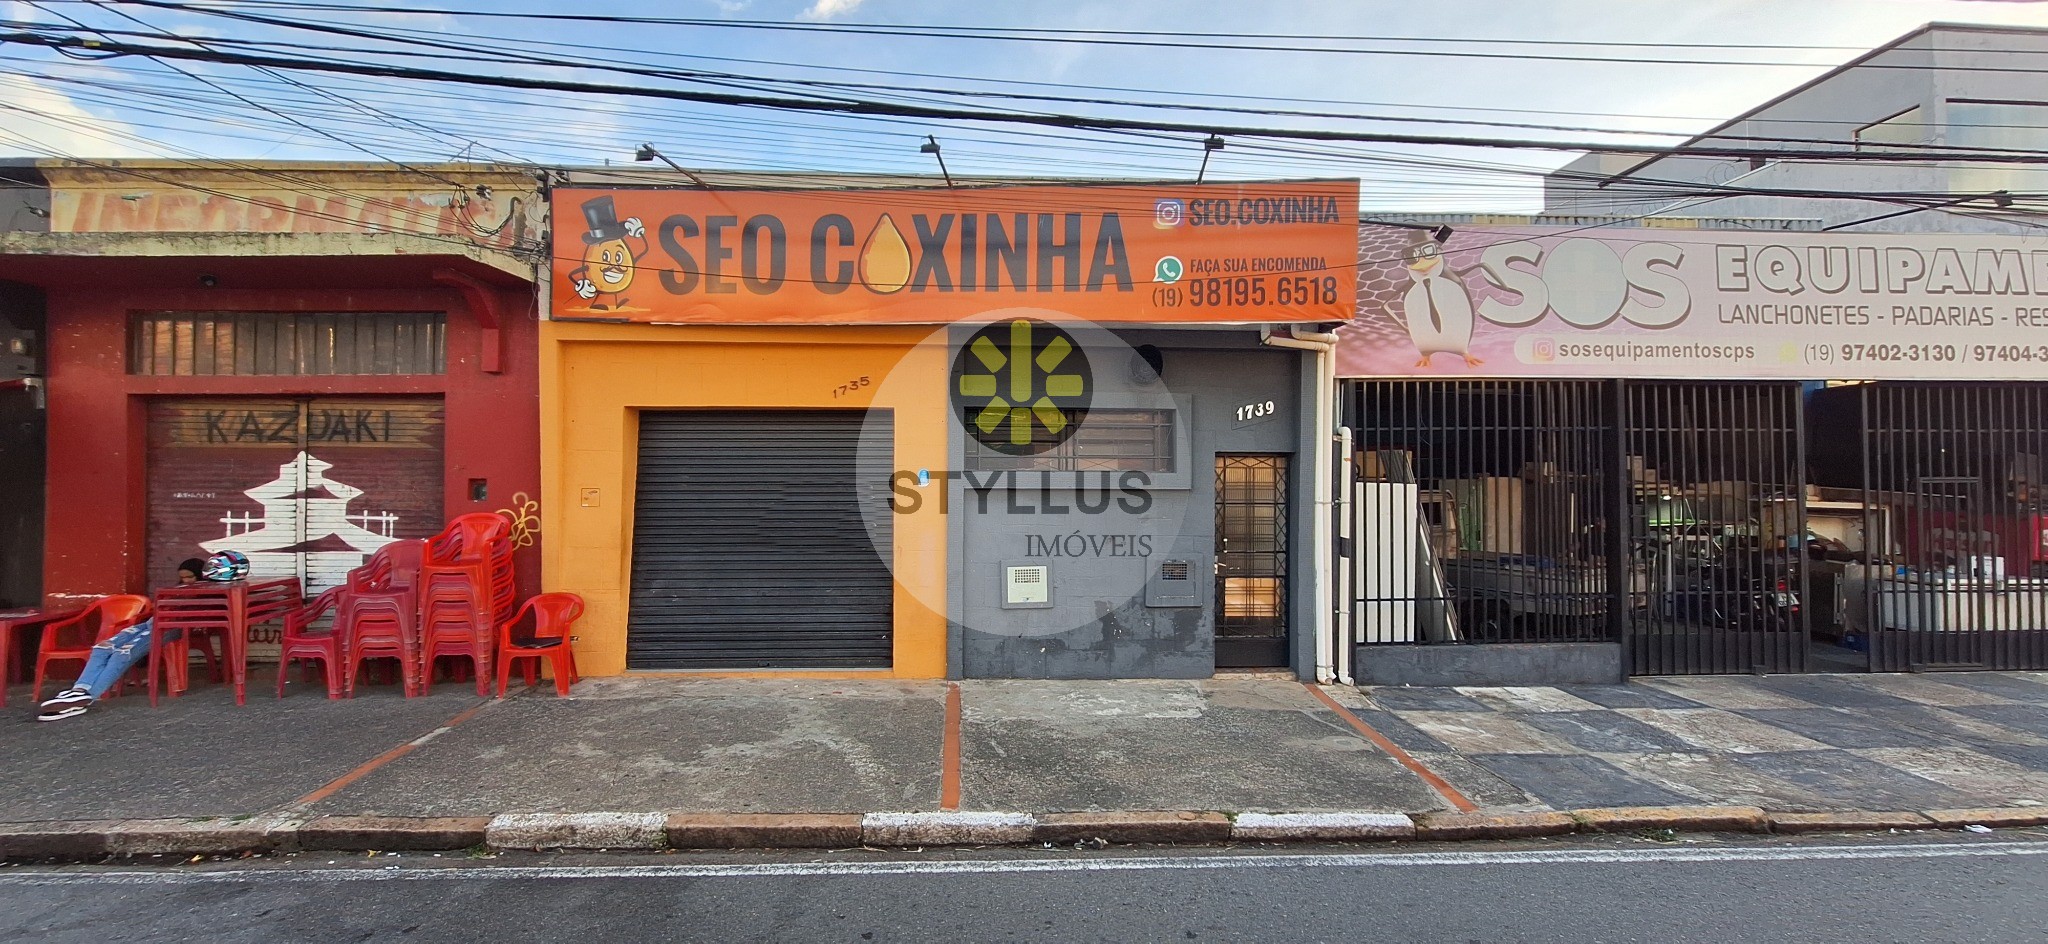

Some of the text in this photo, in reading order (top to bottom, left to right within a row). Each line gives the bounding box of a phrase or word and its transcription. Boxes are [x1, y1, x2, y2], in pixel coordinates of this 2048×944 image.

[1189, 195, 1340, 227] SEO.COXINHA
[658, 212, 1134, 296] SEO COXINHA
[1190, 256, 1327, 277] FAÇA SUA ENCOMENDA
[1152, 276, 1338, 308] (19) 98195.6518
[1477, 237, 1692, 331] SOS
[1718, 304, 1869, 325] LANCHONETES
[1892, 306, 1993, 327] PADARIAS
[2015, 307, 2048, 327] RES
[1559, 341, 1755, 361] sosequipamentoscps
[1804, 344, 1835, 364] (19)
[1841, 345, 1956, 362] 97402-3130
[1973, 345, 2048, 362] 97404-3
[833, 376, 870, 399] 1735
[1236, 400, 1275, 421] 1739
